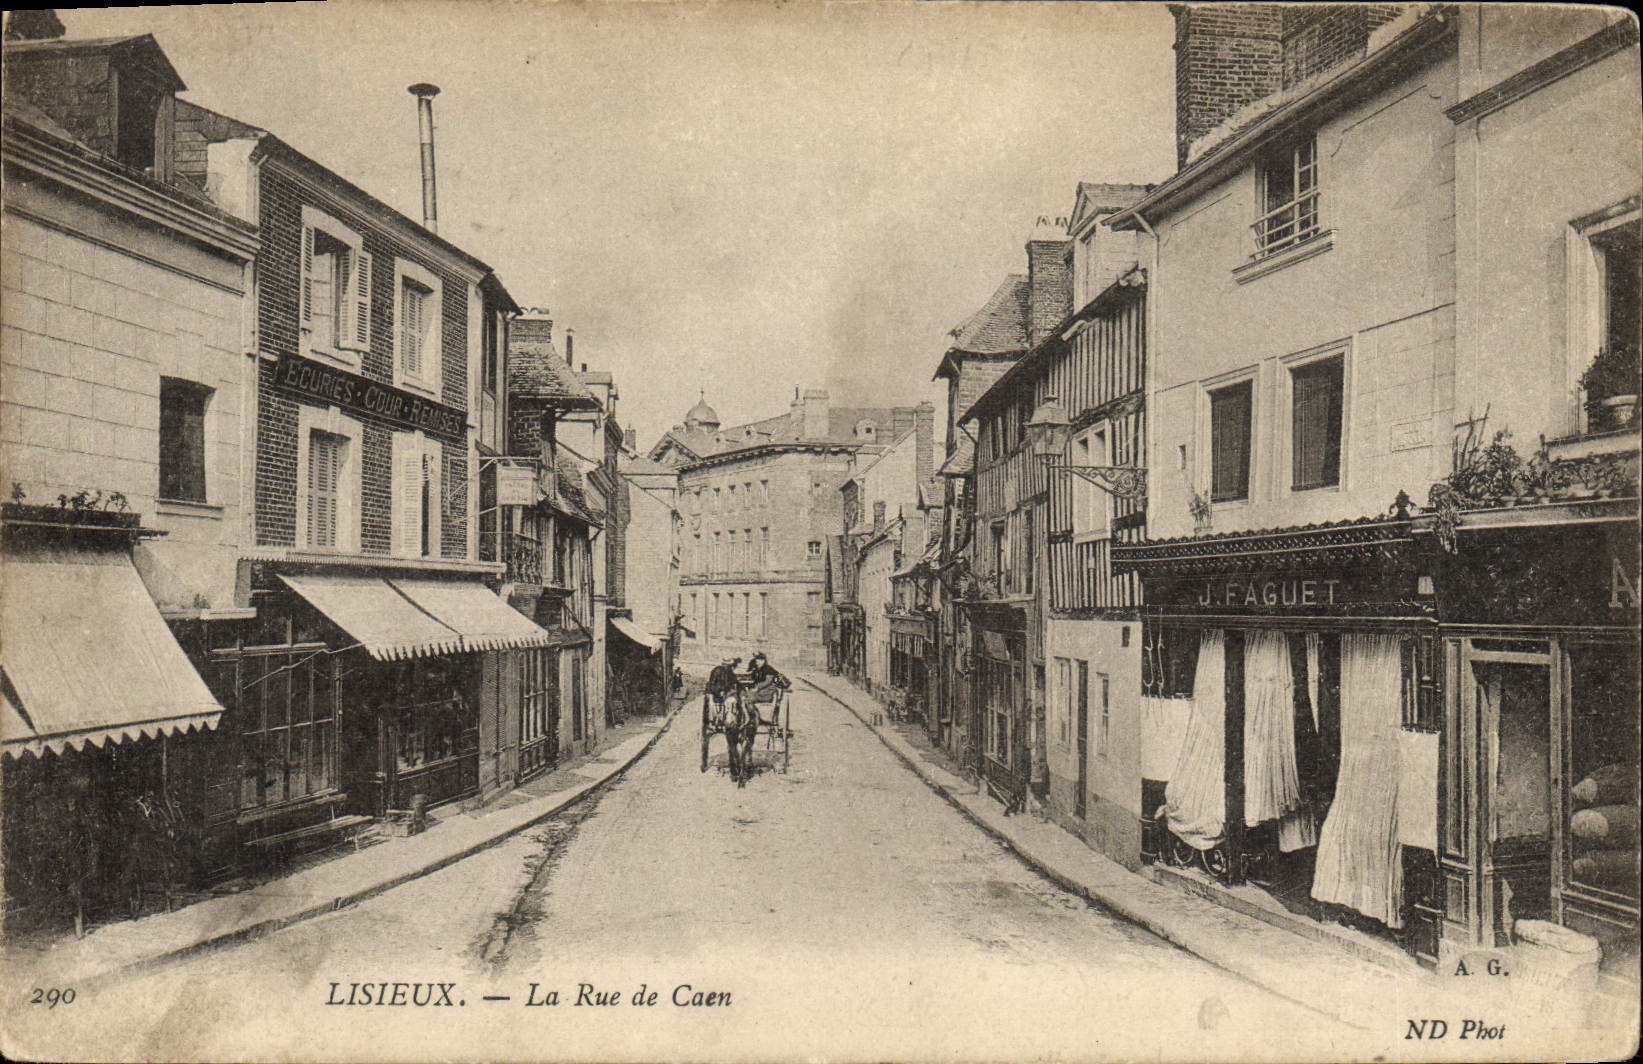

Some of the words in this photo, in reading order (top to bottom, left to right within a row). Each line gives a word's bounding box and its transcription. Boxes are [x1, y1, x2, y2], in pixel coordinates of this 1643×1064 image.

[364, 385, 403, 418] COUR
[408, 399, 462, 434] REMISES
[1225, 579, 1340, 606] FAGUET
